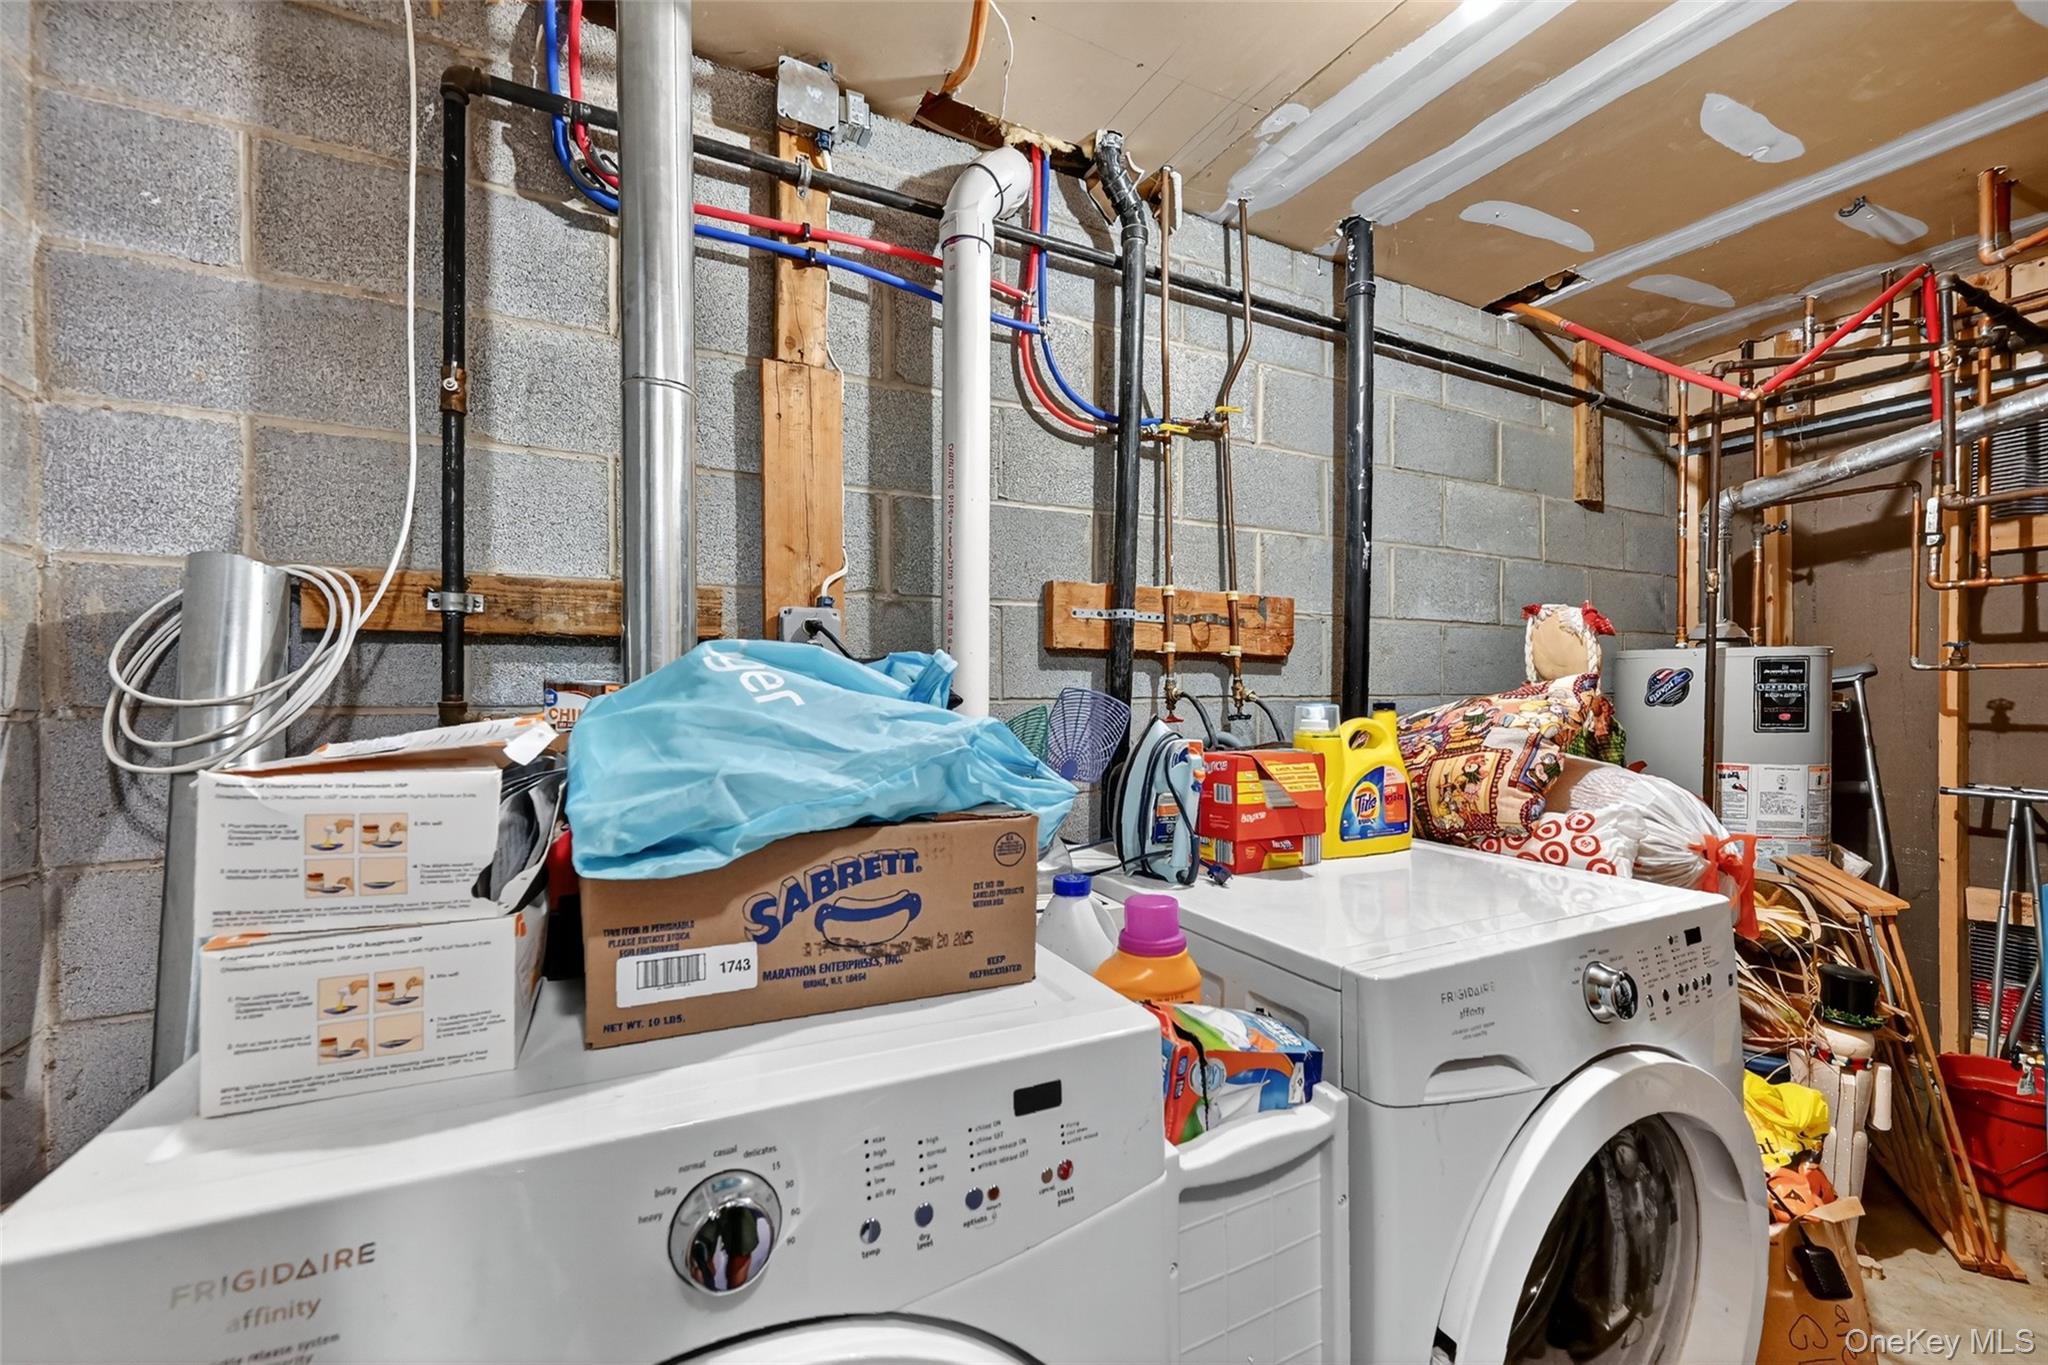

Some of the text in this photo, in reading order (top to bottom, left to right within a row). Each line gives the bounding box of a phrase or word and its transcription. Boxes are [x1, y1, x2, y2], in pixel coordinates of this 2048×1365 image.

[743, 848, 918, 944] SABRETT
[719, 958, 751, 974] 1743
[762, 965, 816, 982] MARATHON
[1441, 981, 1496, 1004] FRIGIDAIRE
[603, 1021, 624, 1034] NET
[626, 1018, 644, 1030] WT.
[648, 1017, 660, 1028] 10
[713, 1144, 738, 1158] casual
[743, 1144, 778, 1159] delicates
[678, 1160, 706, 1173] normal
[772, 1160, 781, 1171] 15
[785, 1179, 794, 1188] 30
[654, 1186, 677, 1198] bulky
[638, 1212, 663, 1224] heavy
[791, 1207, 800, 1216] 60
[169, 1242, 376, 1310] FRIGIDAIRE
[226, 1298, 322, 1334] affinity
[298, 1333, 340, 1351] system
